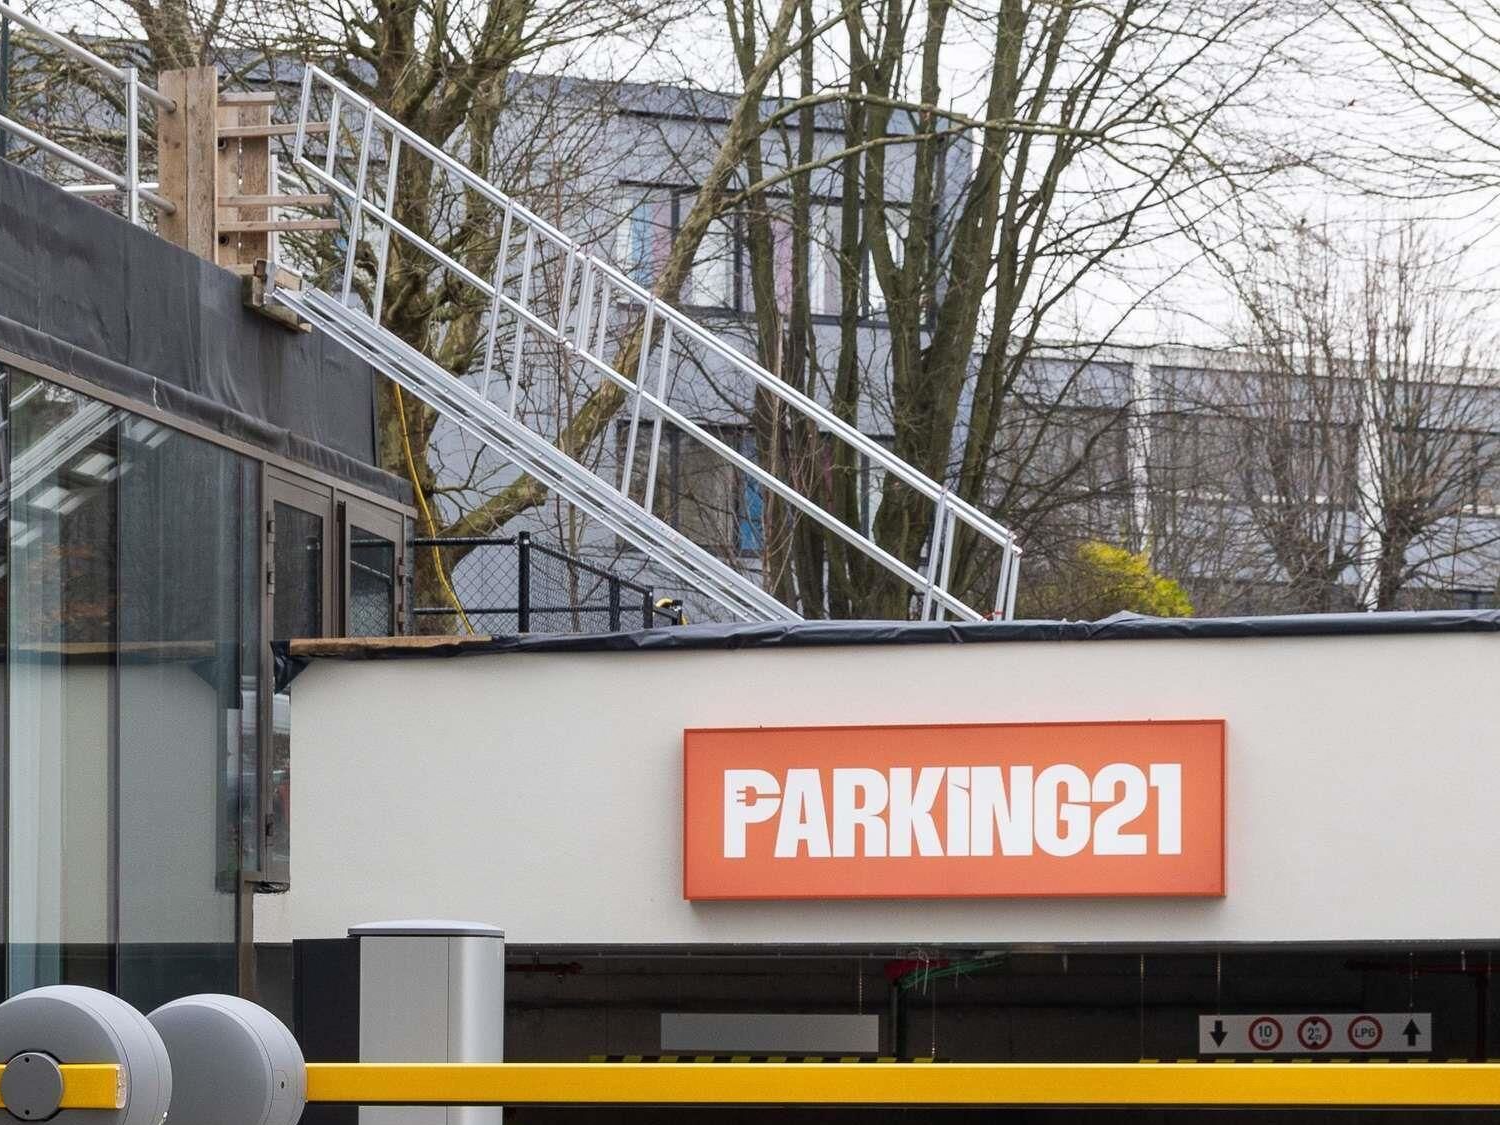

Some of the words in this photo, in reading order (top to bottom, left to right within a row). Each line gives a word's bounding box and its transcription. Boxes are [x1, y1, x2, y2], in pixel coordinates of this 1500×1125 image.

[724, 762, 1182, 858] PARKING21
[1258, 1025, 1273, 1038] 10
[1354, 1027, 1376, 1039] LPG
